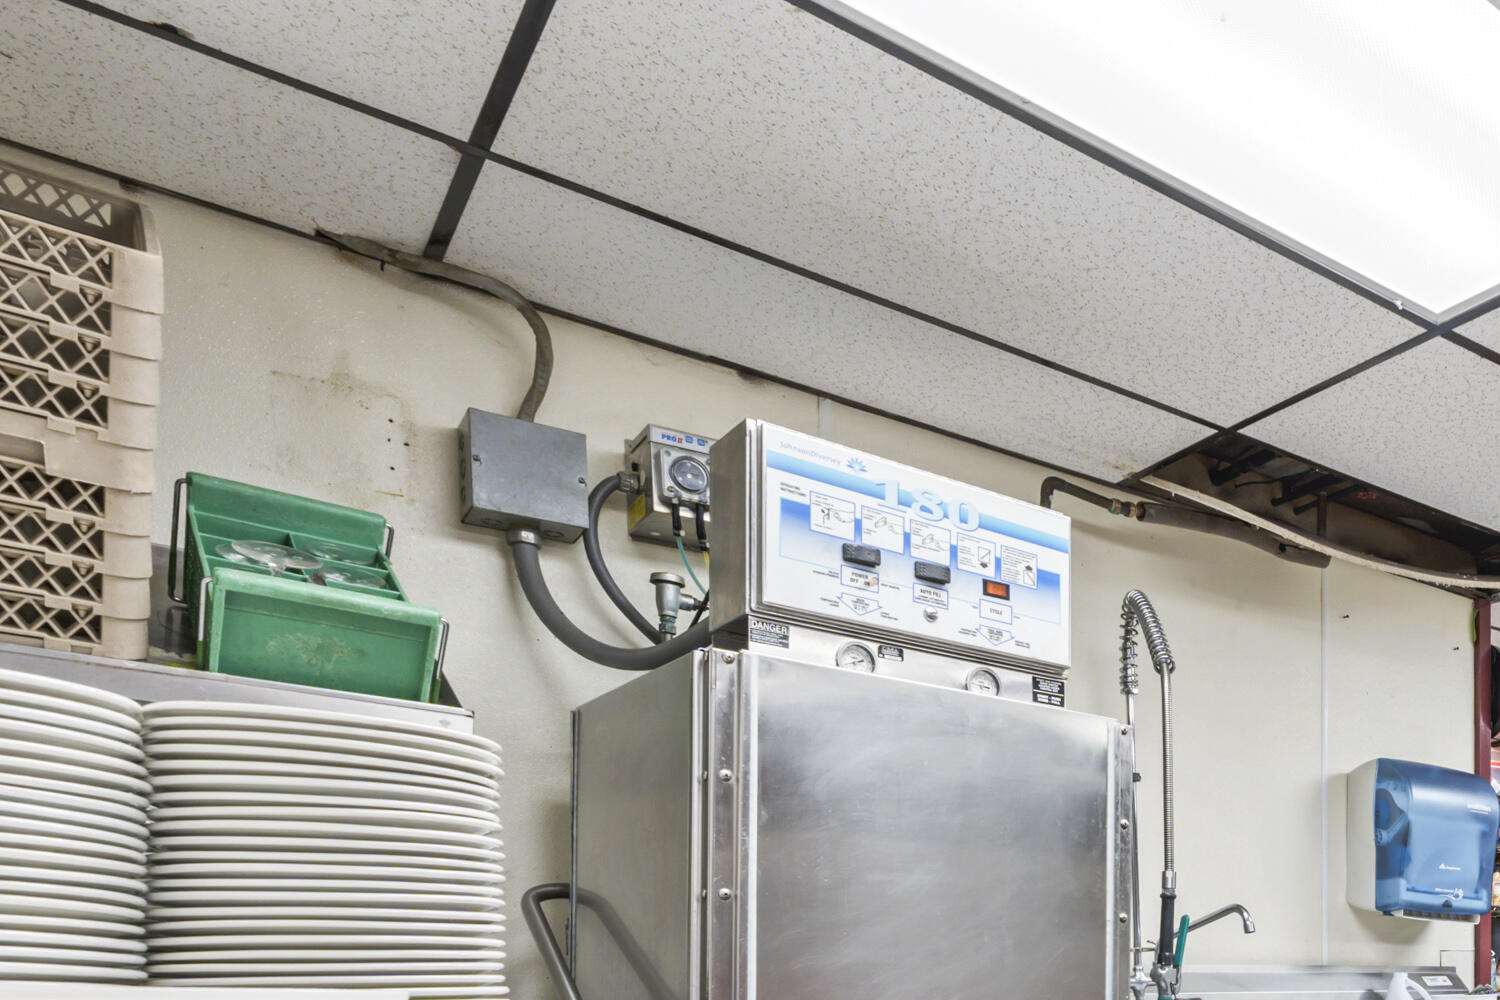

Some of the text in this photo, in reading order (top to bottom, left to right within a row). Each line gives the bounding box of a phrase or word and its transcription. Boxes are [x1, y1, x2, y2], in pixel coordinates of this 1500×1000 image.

[873, 478, 981, 533] 180
[851, 571, 869, 580] POWER
[751, 619, 787, 635] DANGER
